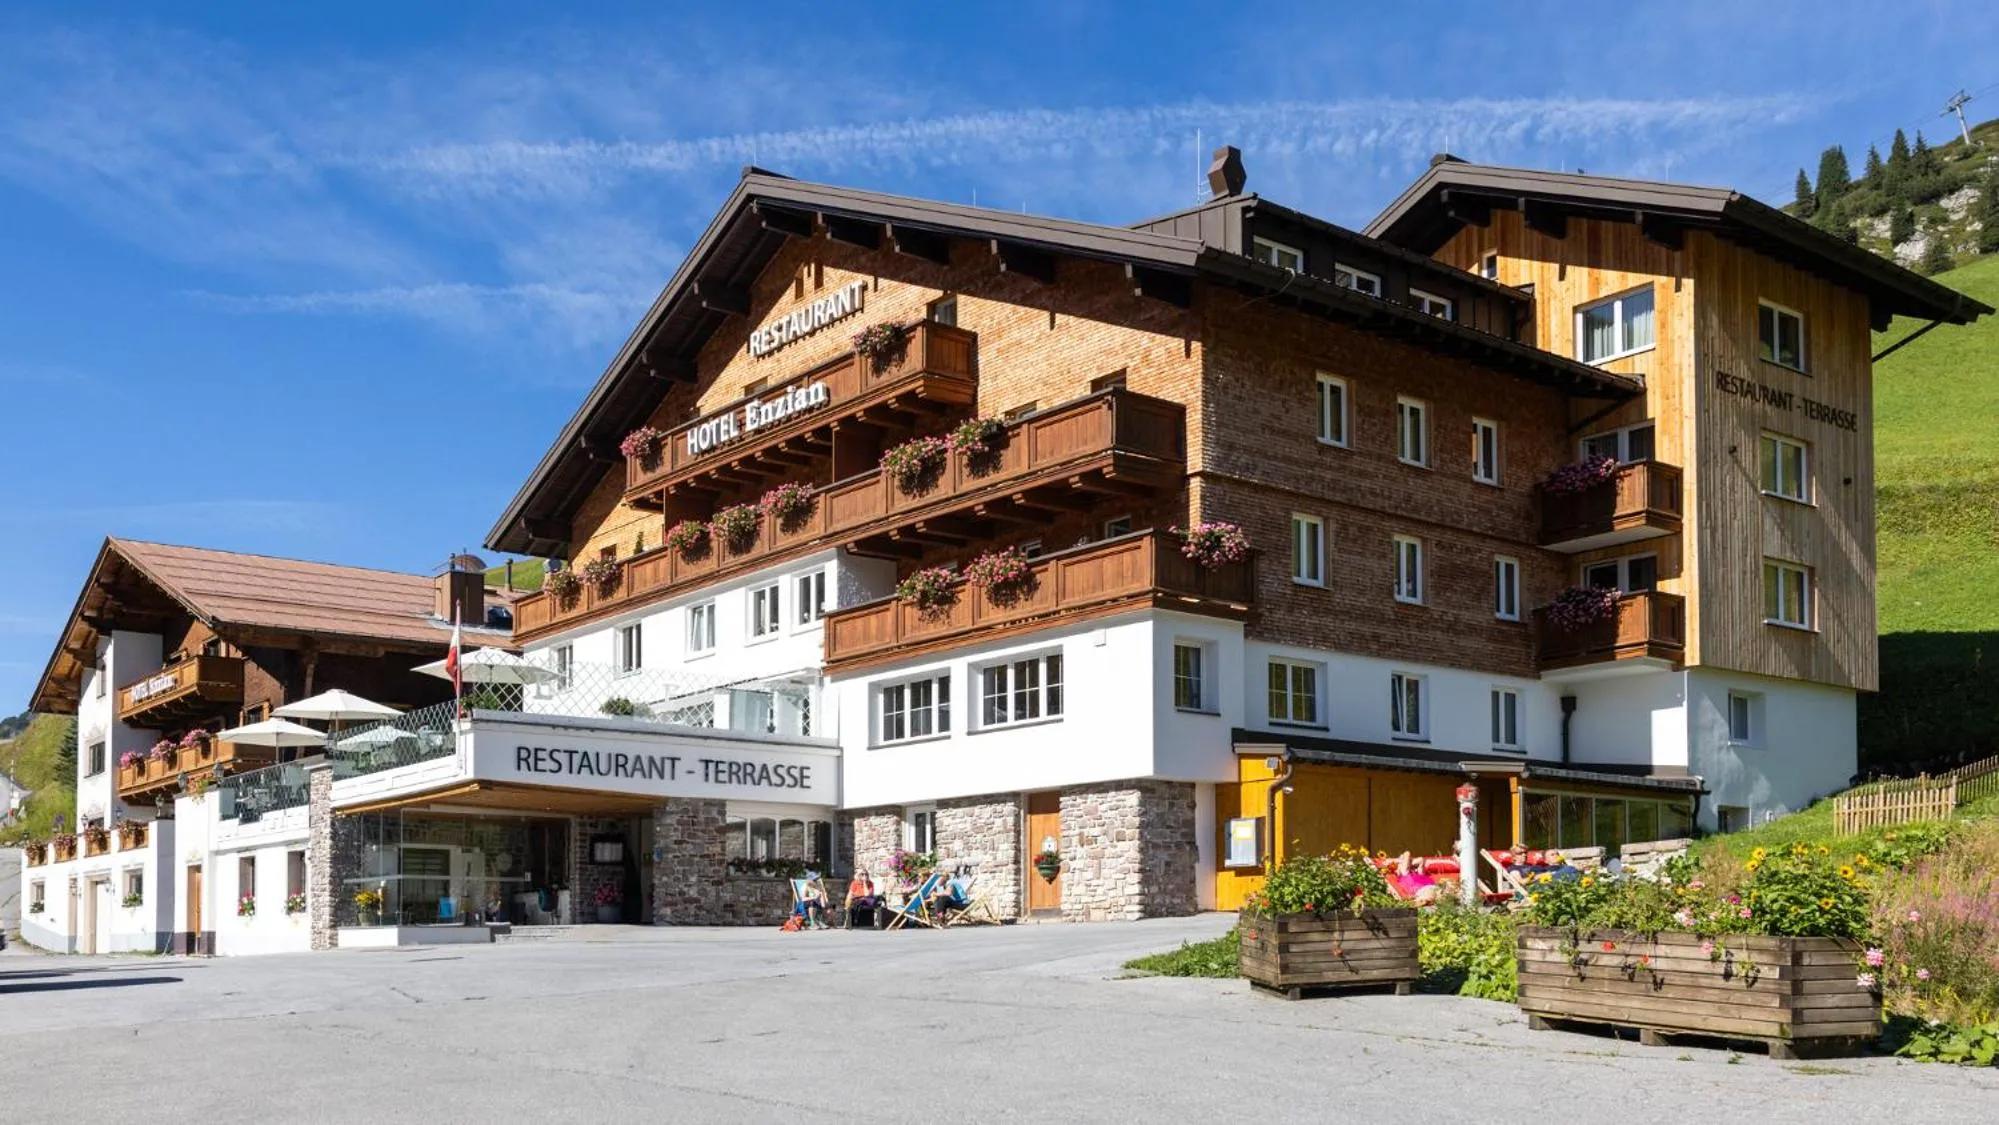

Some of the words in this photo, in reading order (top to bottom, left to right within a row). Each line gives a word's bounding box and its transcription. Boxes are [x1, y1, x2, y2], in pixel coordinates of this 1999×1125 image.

[750, 279, 865, 357] RESTAURANT
[687, 412, 739, 455] HOTEL
[744, 381, 828, 431] Enzian
[1716, 371, 1794, 412] RESTAURANT
[1803, 398, 1858, 432] TERRASSE
[516, 746, 681, 781] RESTAURANT
[699, 759, 812, 789] TERRASSE
